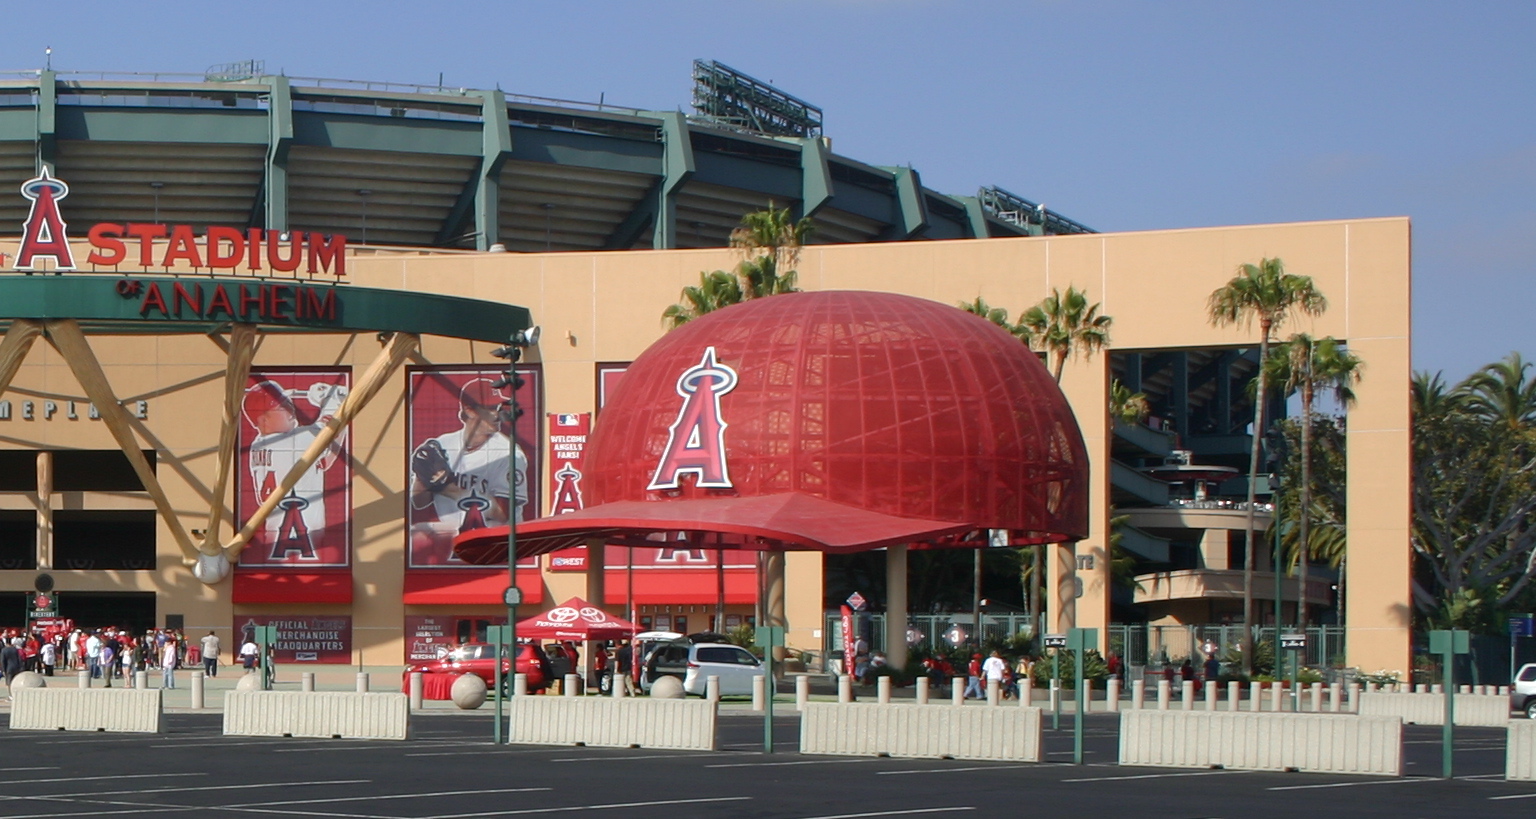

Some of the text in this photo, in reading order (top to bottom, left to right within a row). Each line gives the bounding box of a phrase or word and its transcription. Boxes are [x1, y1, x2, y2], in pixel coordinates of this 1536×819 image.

[12, 164, 76, 270] A
[87, 223, 347, 276] STADIUM
[139, 281, 337, 320] ANAHEIM
[646, 346, 738, 491] A
[550, 435, 586, 443] WELCOME
[554, 443, 583, 451] ANGELS
[642, 605, 707, 613] TICKET
[268, 621, 308, 630] OFFICIAL
[276, 631, 339, 640] MERCHANDISE
[951, 630, 959, 642] 3
[273, 641, 344, 651] HEADQUARTERS
